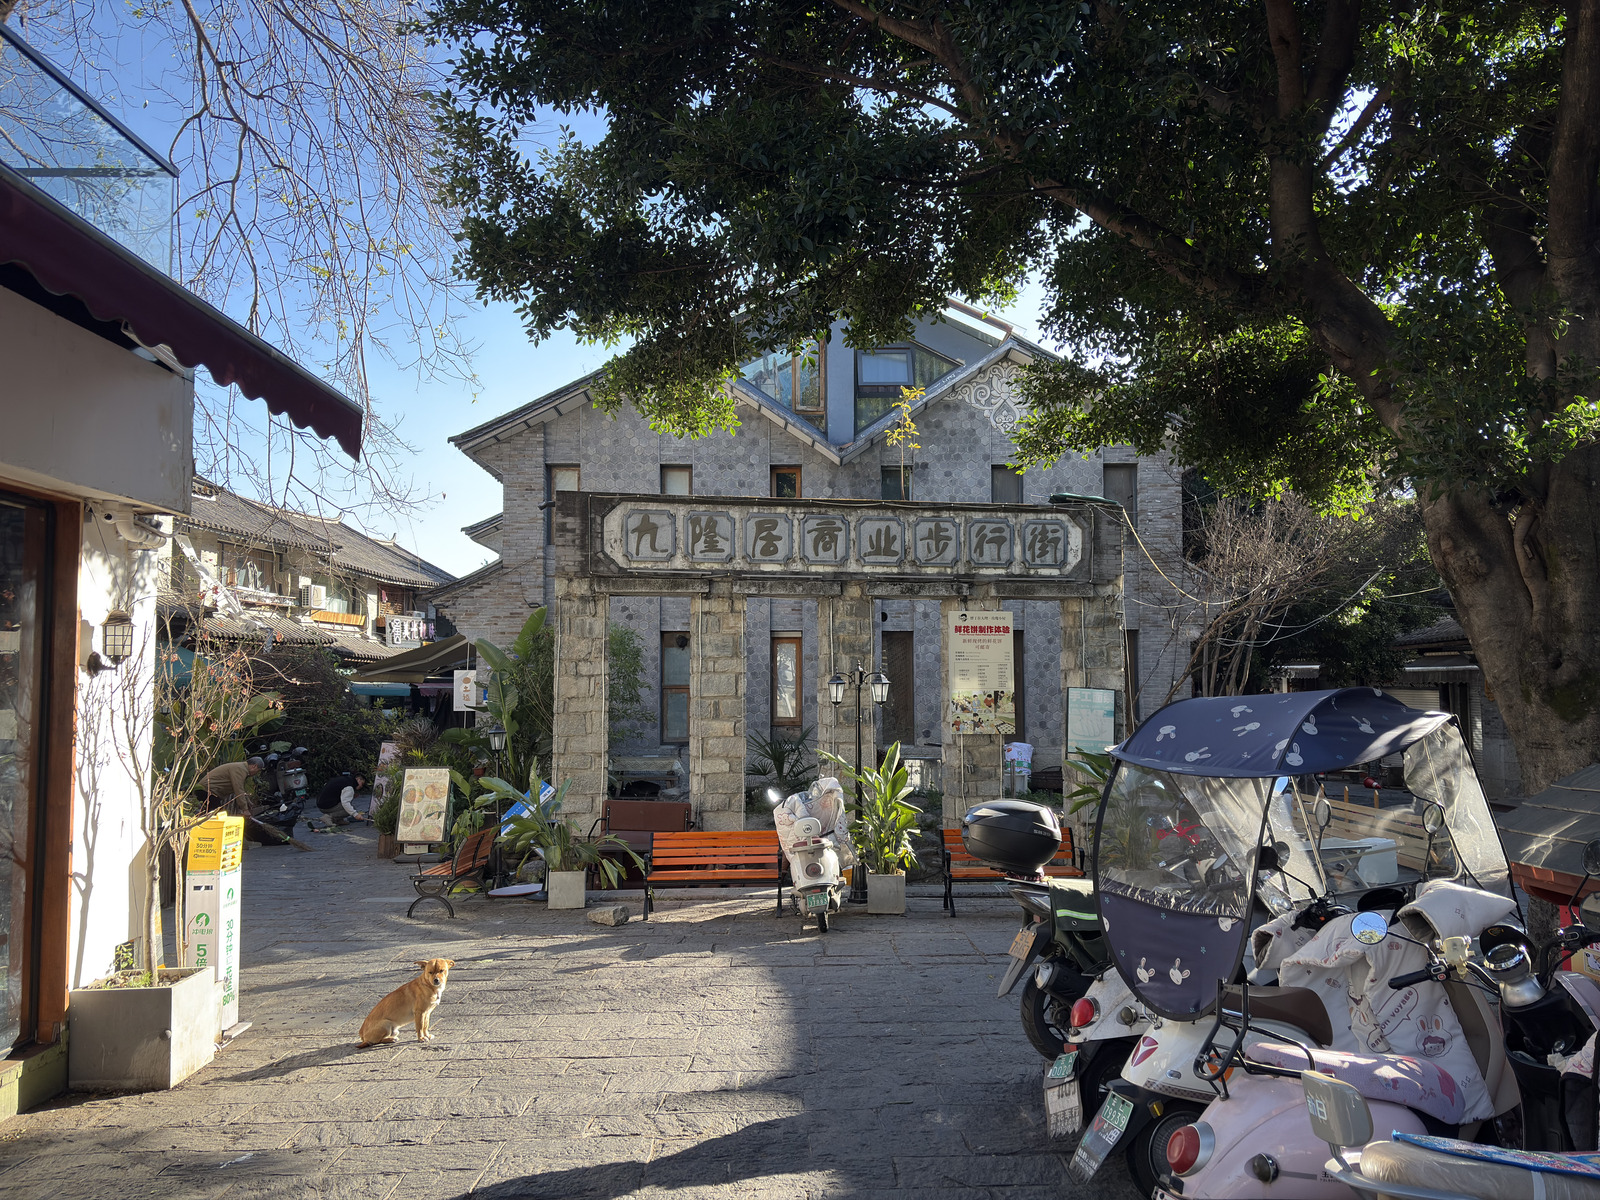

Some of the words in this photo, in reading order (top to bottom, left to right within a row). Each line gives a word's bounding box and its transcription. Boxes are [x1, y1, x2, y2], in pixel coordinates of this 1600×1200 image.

[630, 514, 1066, 564] 九隆居商业步行街
[1103, 1105, 1127, 1128] 79939
